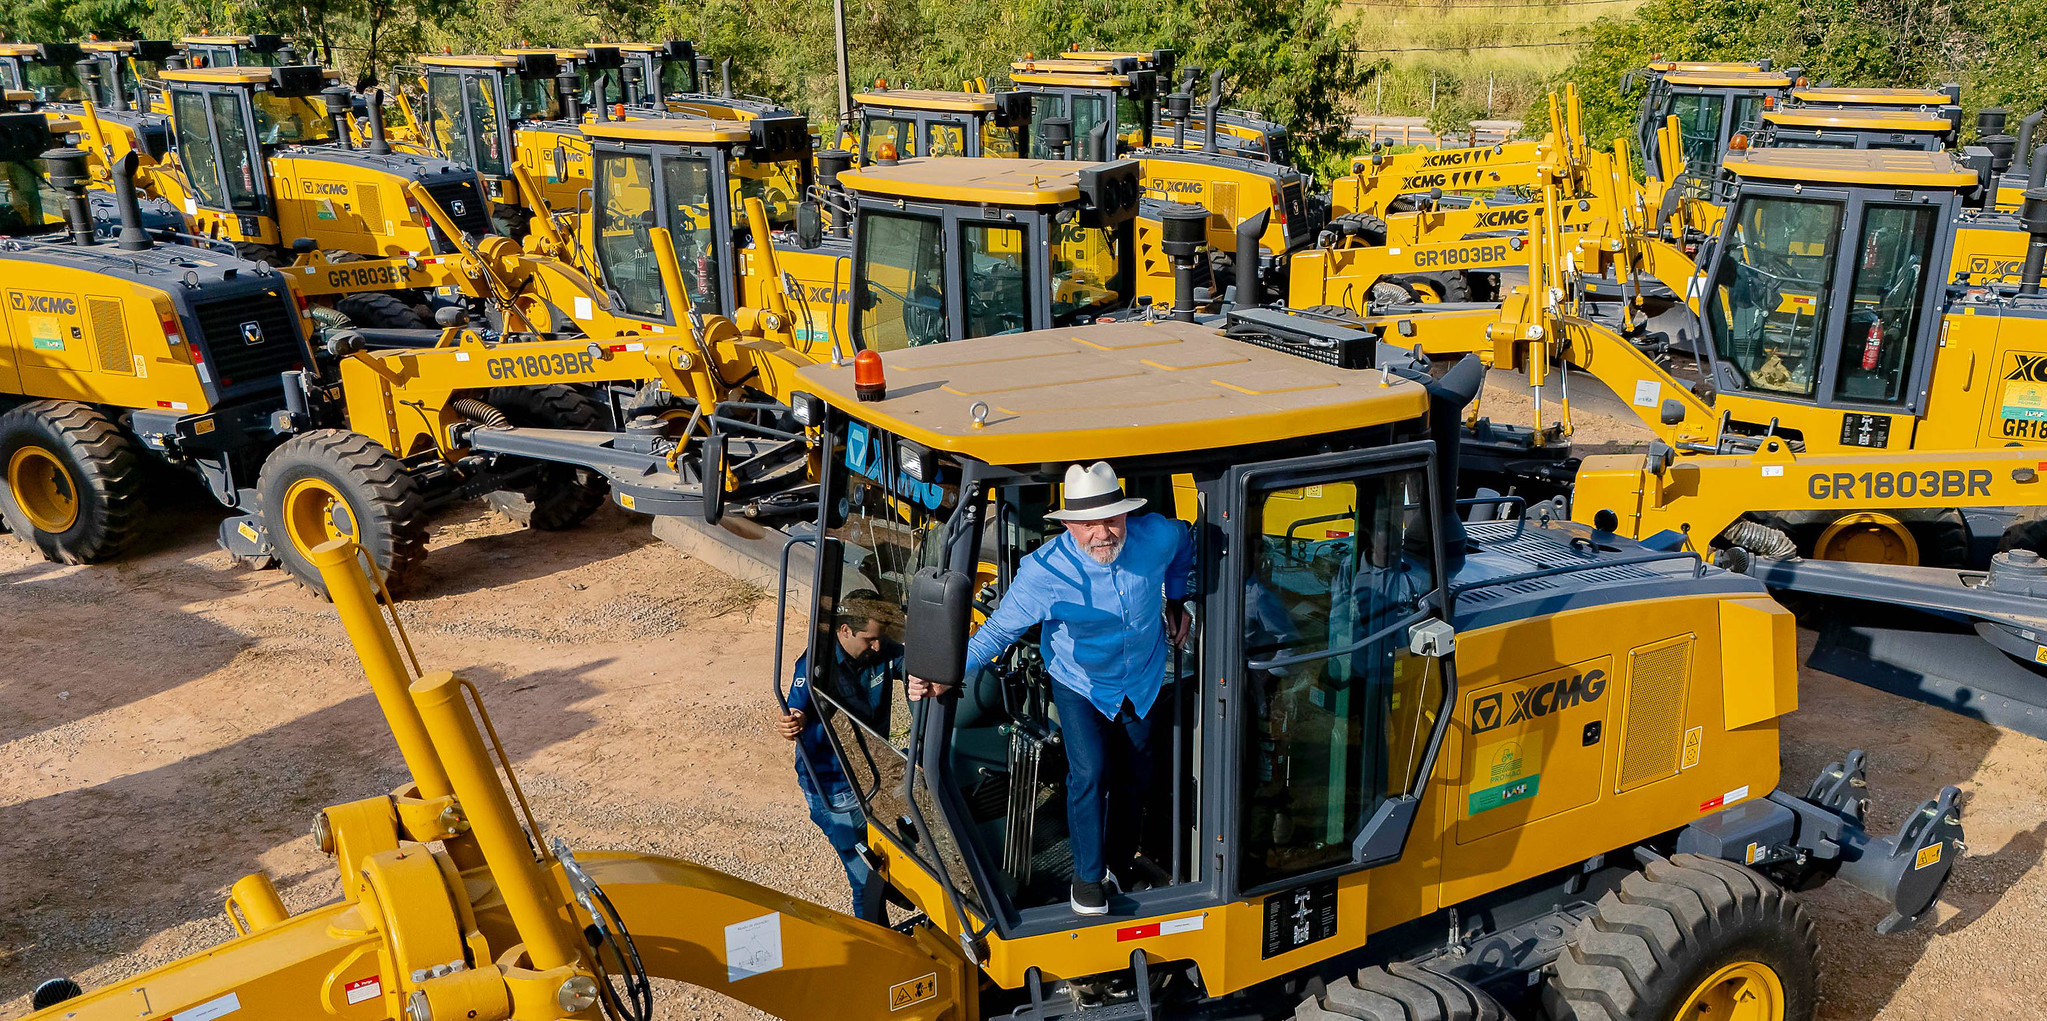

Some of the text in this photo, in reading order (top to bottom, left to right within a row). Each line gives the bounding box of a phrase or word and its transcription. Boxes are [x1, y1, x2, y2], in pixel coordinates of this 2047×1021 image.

[1420, 153, 1463, 168] XCMG
[314, 183, 349, 196] XCMG
[1165, 179, 1203, 194] XCMG
[1400, 173, 1446, 190] XCMG
[1473, 209, 1529, 229] XCMG
[1414, 245, 1507, 268] GR1803BR
[327, 265, 412, 289] GR1803BR
[27, 295, 77, 315] XCMG
[486, 351, 596, 380] GR1803BR
[1808, 469, 1993, 499] GR1803BR
[1503, 669, 1607, 727] XCMG
